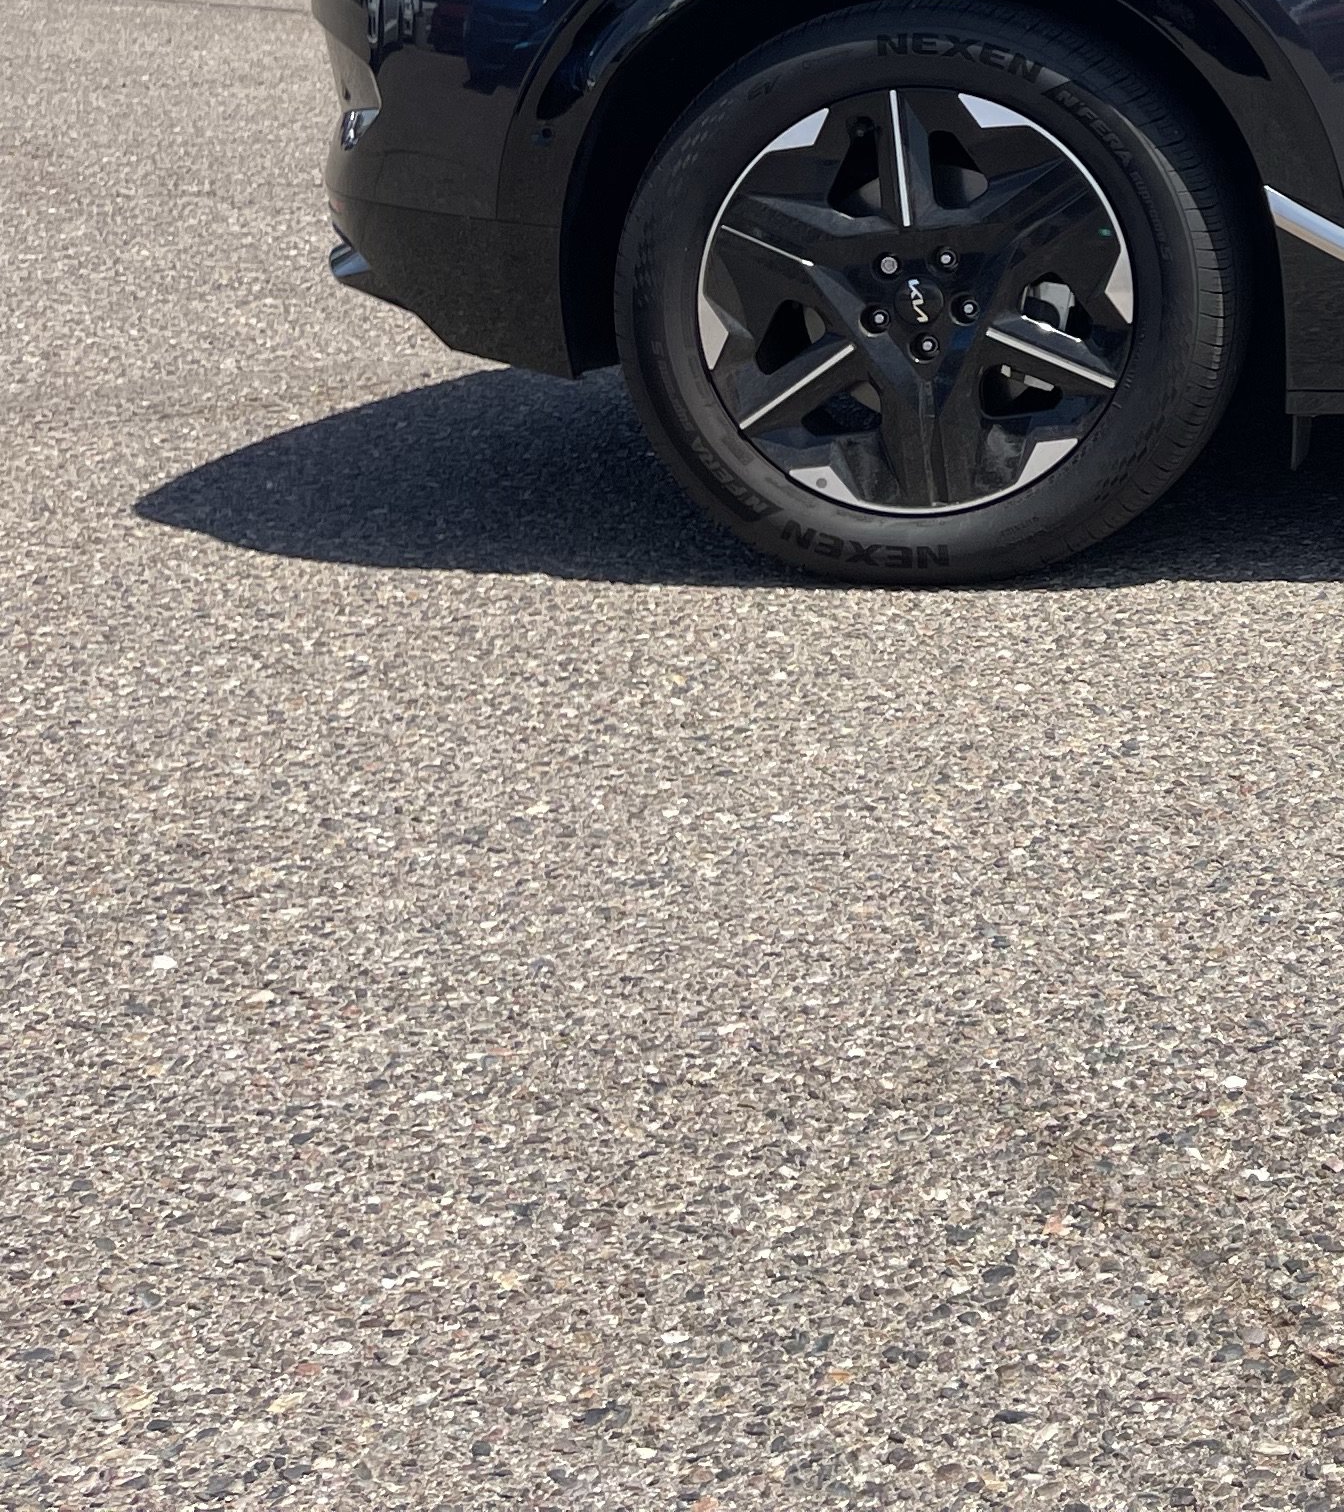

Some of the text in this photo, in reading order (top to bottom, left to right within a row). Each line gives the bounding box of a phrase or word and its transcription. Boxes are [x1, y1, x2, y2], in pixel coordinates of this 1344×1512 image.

[876, 31, 1045, 83] NEXEN
[908, 279, 929, 322] KIA
[780, 519, 950, 569] NEXEN
